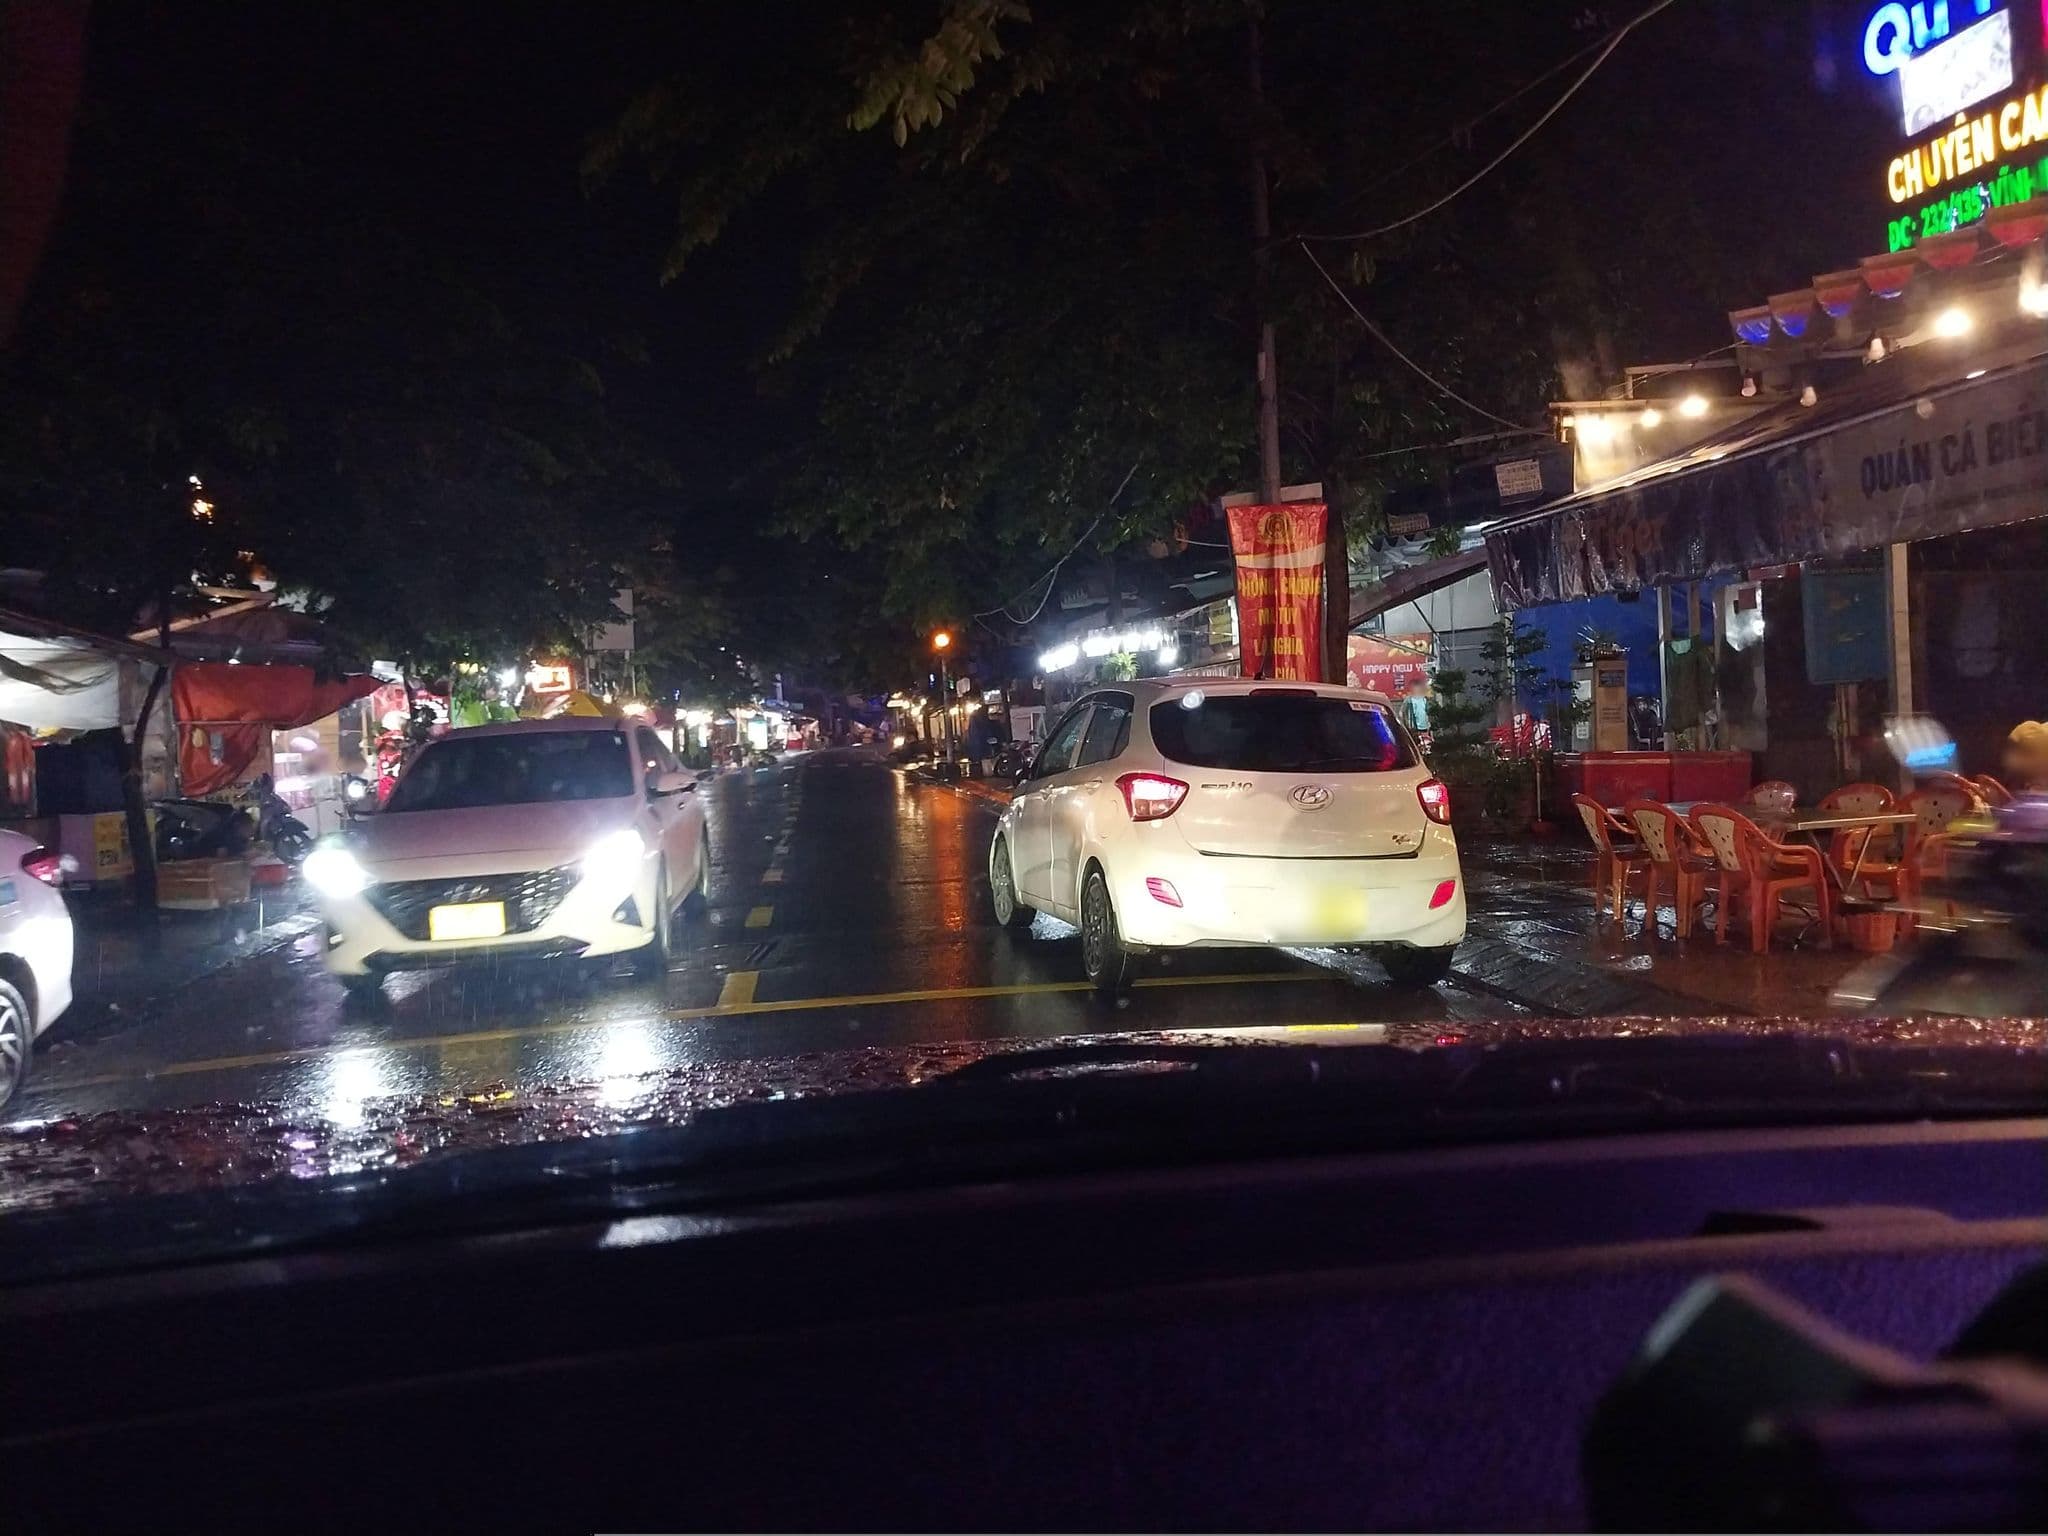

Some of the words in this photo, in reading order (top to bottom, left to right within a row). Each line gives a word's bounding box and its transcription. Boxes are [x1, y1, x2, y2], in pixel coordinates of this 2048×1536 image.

[1864, 0, 1991, 75] Qu
[1888, 112, 1995, 203] CHUYÊN
[1920, 184, 1983, 238] 232/135
[1861, 438, 1933, 499] QUÁN
[1941, 420, 1978, 477] CÁ
[1362, 664, 1391, 675] HAPPY
[1392, 663, 1413, 673] NEW
